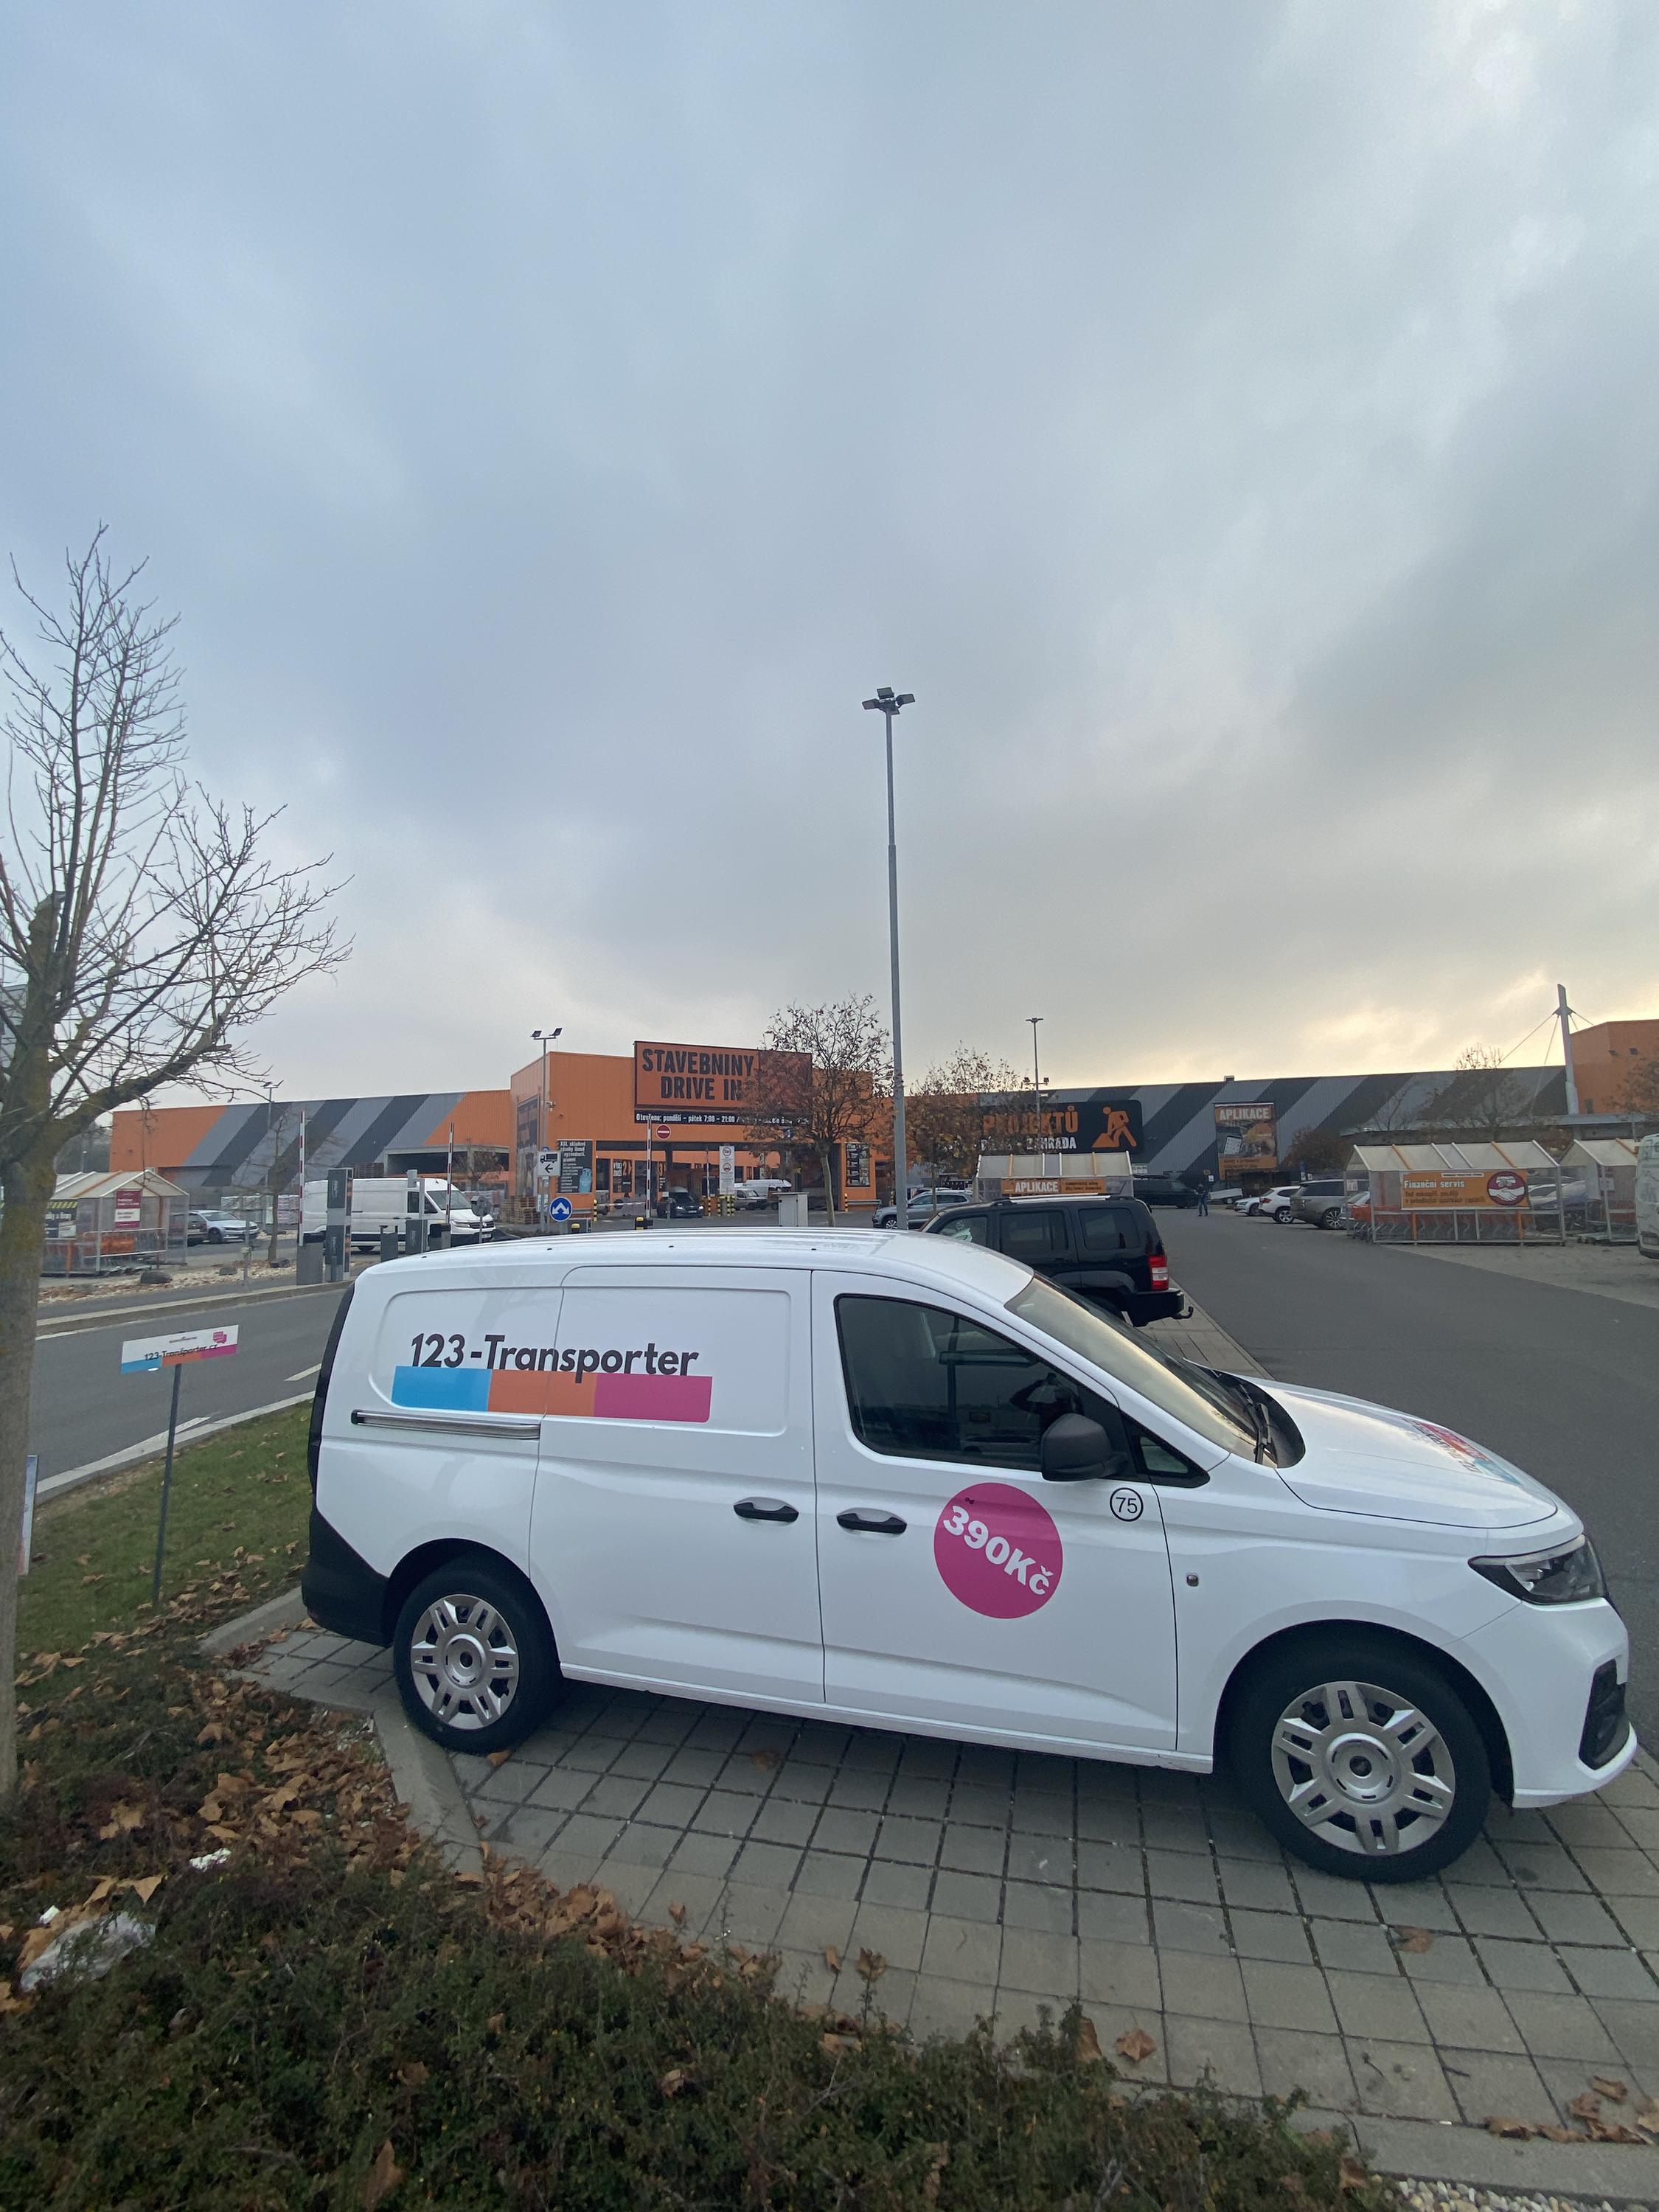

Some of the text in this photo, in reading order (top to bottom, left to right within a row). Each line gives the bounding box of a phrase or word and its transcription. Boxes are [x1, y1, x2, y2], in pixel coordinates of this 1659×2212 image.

[642, 1048, 754, 1076] STAVEBNINY
[661, 1077, 714, 1100] DRIVE
[688, 1115, 702, 1123] pátek
[1220, 1108, 1269, 1121] APLIKACE
[1015, 1181, 1060, 1192] APLIKACE
[1404, 1180, 1437, 1189] Finanční
[411, 1333, 699, 1384] 123-Transporter
[1116, 1498, 1138, 1514] 75
[943, 1506, 1054, 1595] 390Kč
